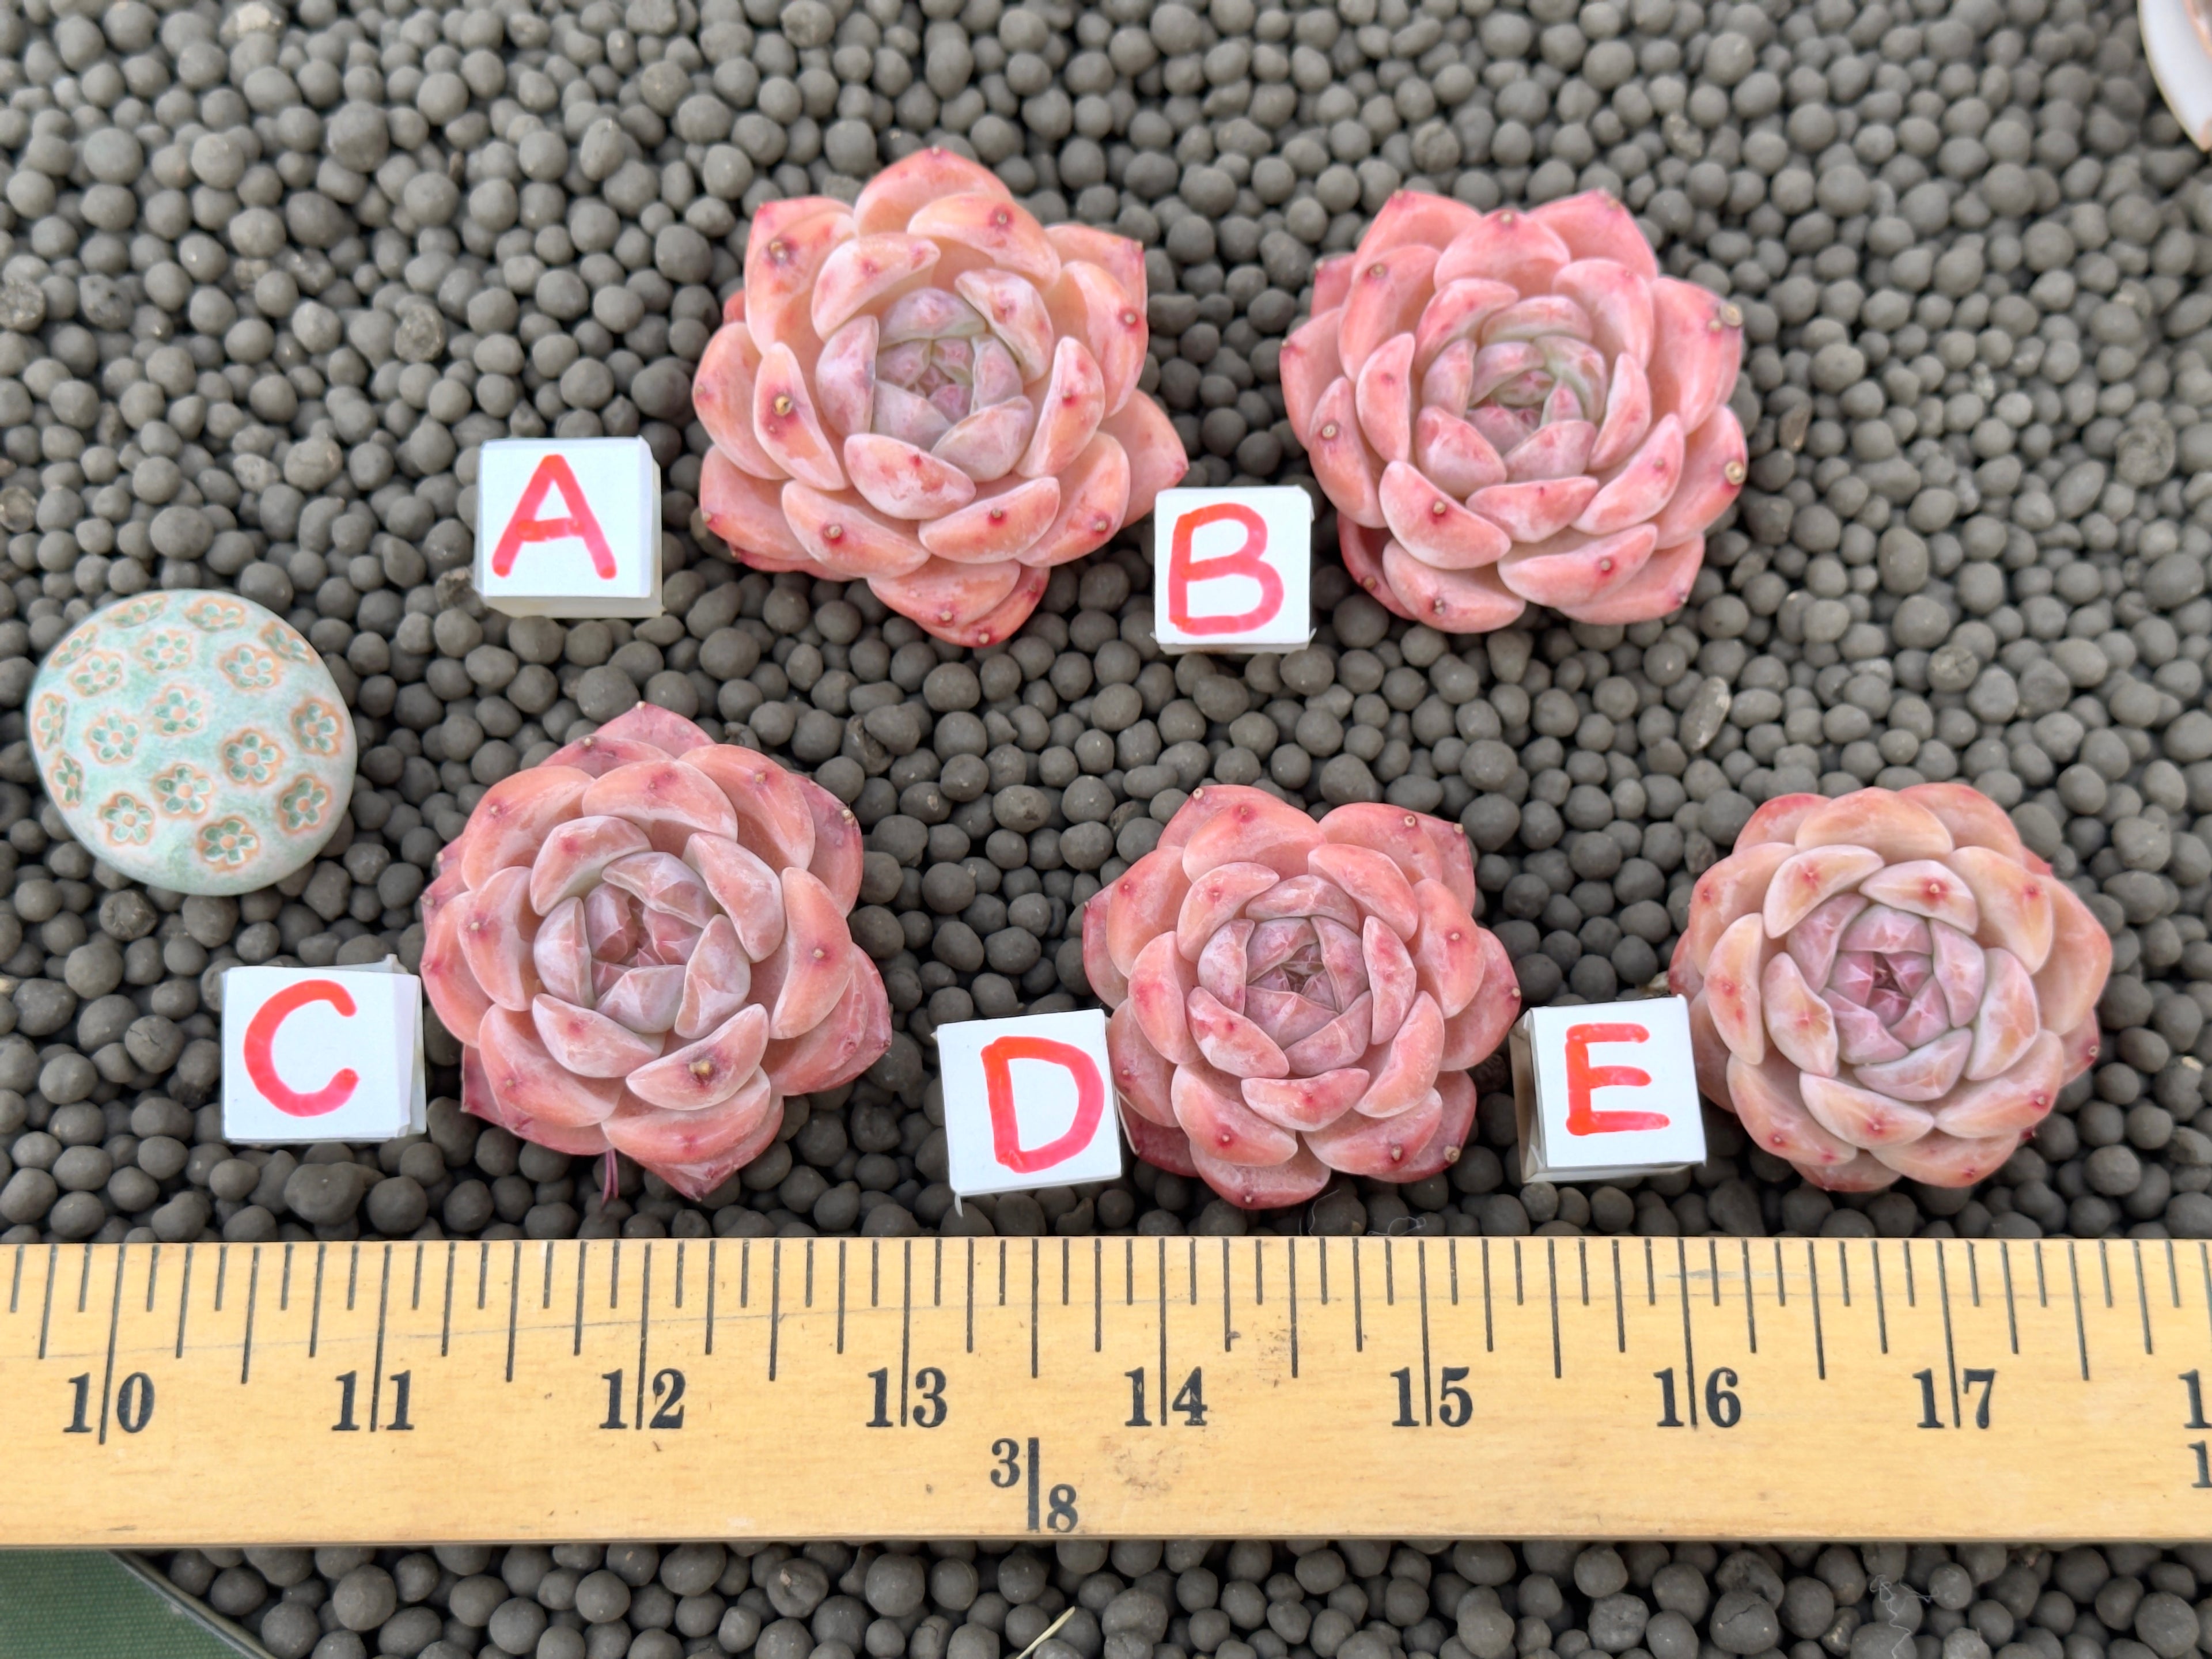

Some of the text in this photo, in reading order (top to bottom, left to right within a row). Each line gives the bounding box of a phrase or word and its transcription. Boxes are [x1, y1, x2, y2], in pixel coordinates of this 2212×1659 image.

[491, 454, 618, 580] A
[1168, 503, 1285, 637] B
[243, 978, 361, 1118] C
[980, 1036, 1105, 1174] D
[1565, 1022, 1671, 1137] E
[64, 1373, 156, 1433] 10
[332, 1371, 415, 1431] 11
[600, 1369, 685, 1430] 12
[866, 1368, 948, 1428] 13
[1125, 1368, 1208, 1426] 14
[1391, 1368, 1474, 1427] 15
[1654, 1368, 1741, 1428] 16
[1914, 1369, 1995, 1430] 17
